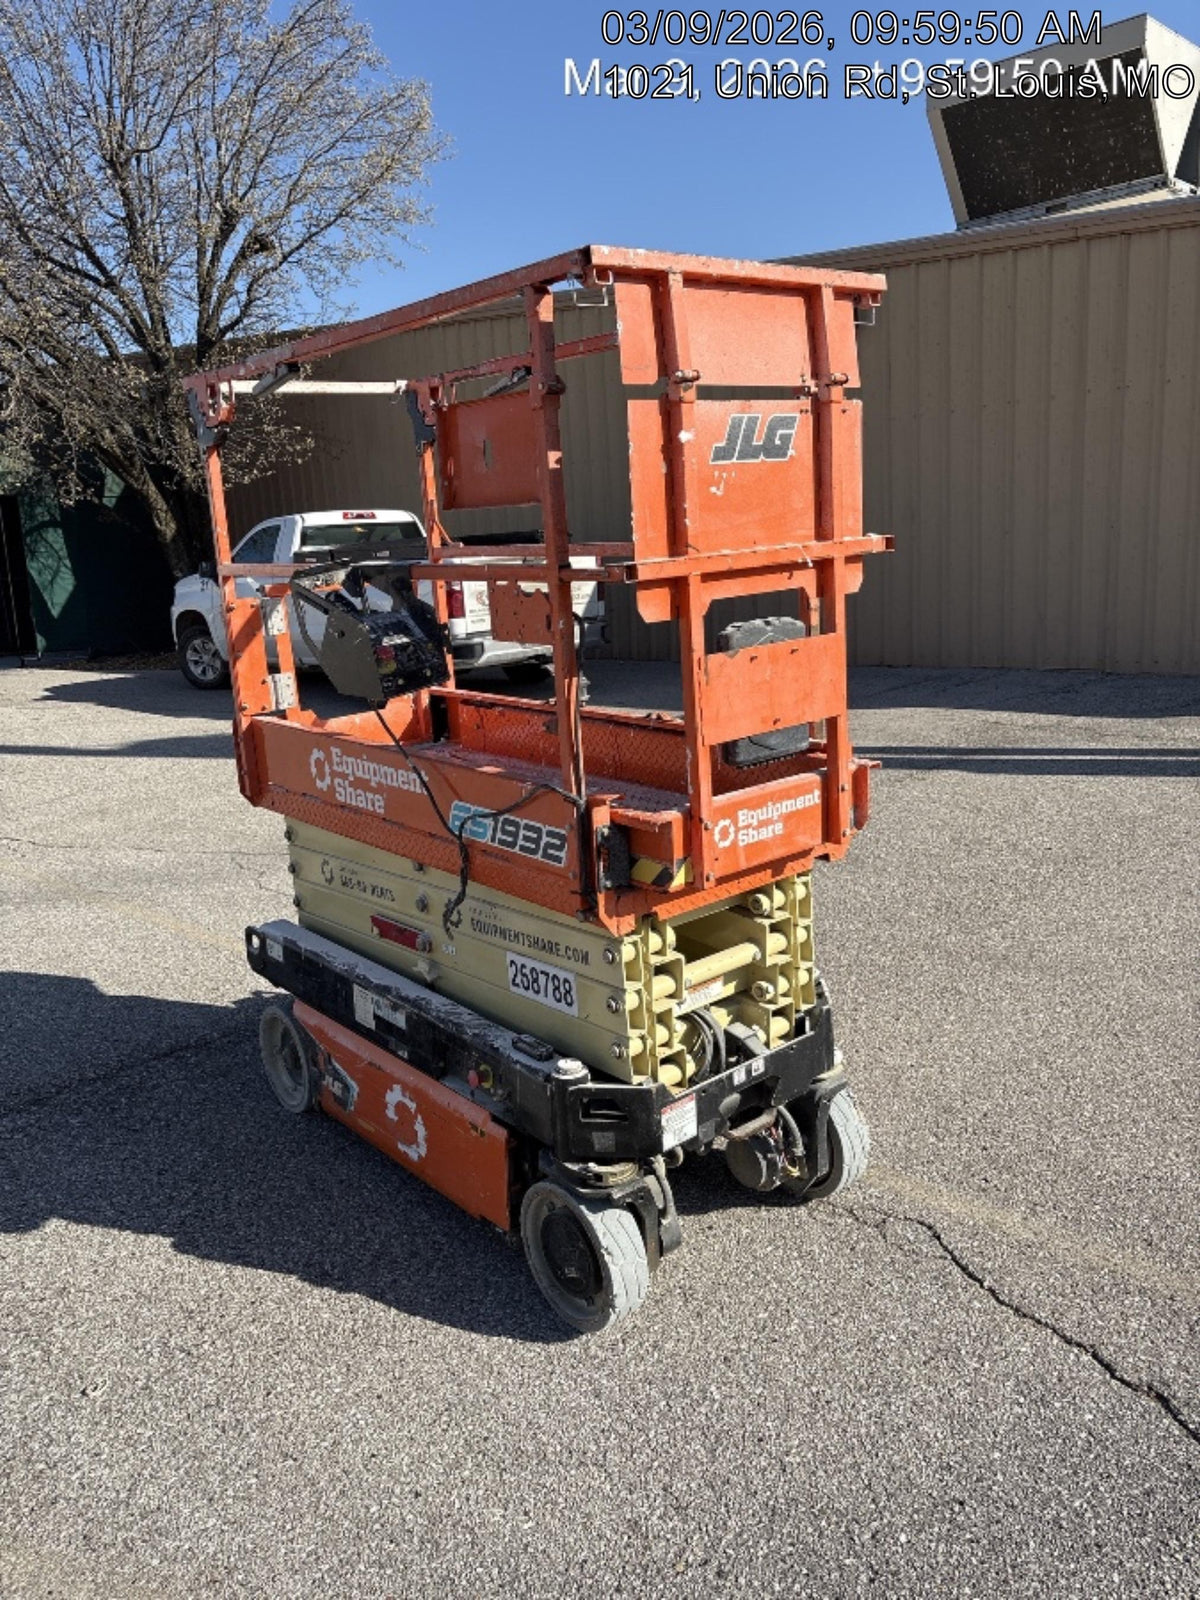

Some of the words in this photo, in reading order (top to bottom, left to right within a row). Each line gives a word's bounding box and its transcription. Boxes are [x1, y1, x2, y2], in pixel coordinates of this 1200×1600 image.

[709, 413, 800, 464] JLG
[334, 778, 384, 814] Share
[737, 788, 820, 827] Equipment
[450, 800, 568, 867] ES1932
[738, 822, 783, 846] Share
[470, 916, 591, 966] EQUIPMENTSHARE.COM
